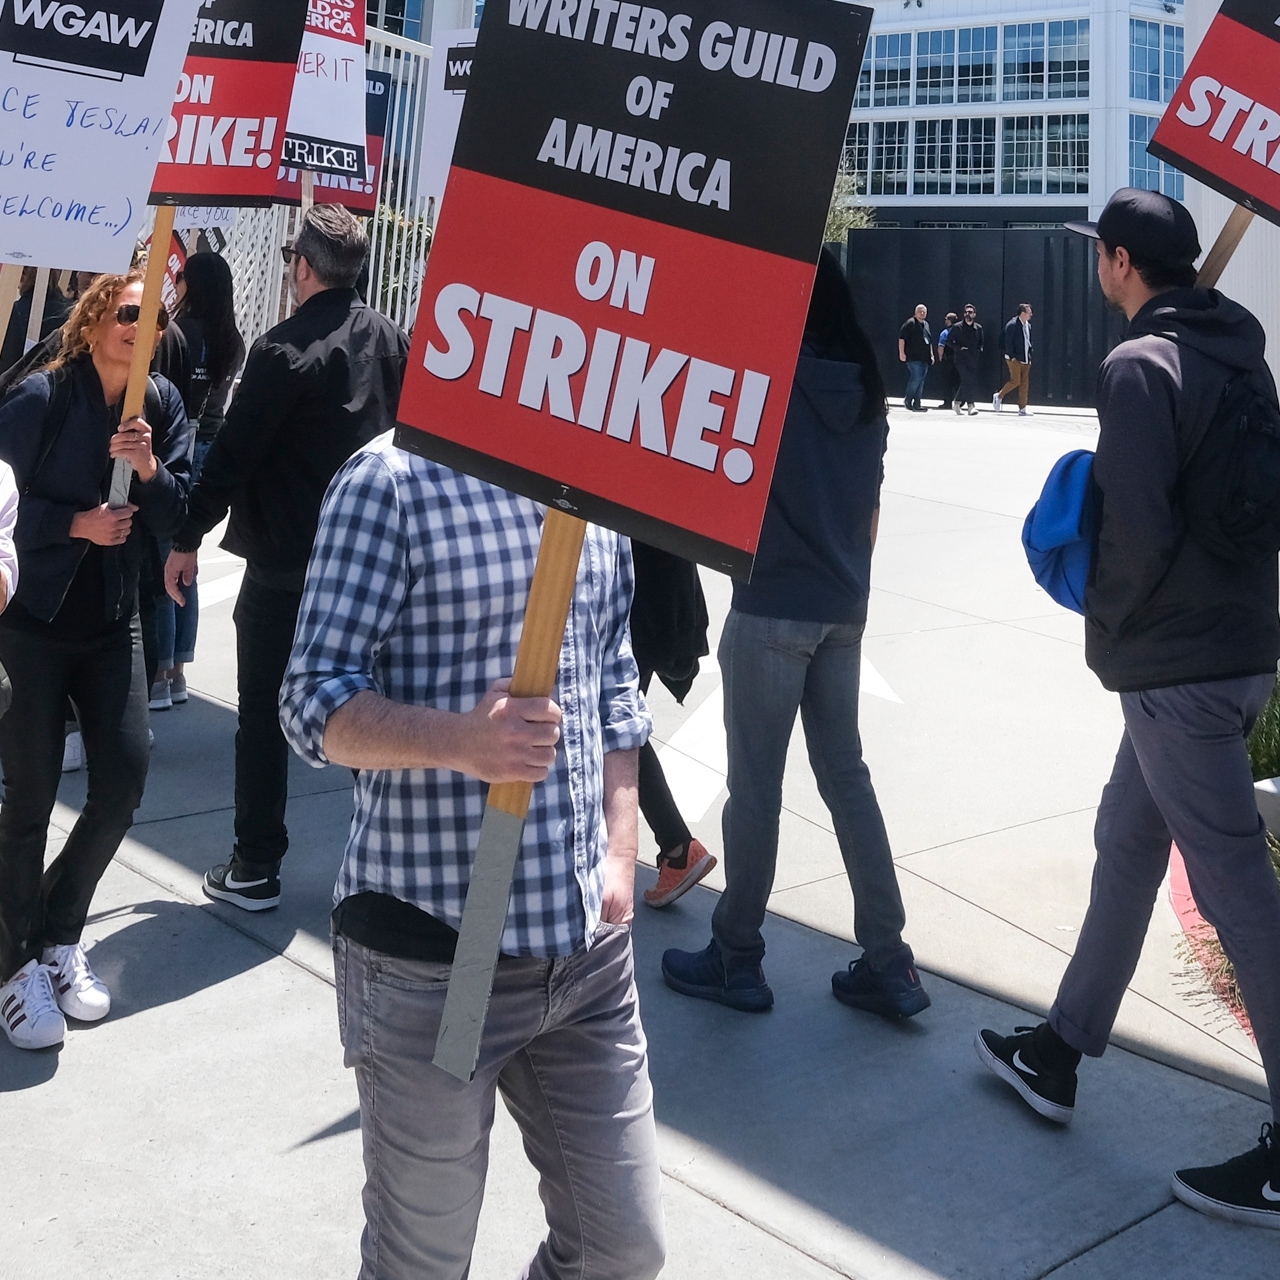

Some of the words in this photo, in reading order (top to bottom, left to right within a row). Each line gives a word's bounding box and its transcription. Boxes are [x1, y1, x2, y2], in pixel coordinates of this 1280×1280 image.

[190, 18, 254, 48] RICA
[305, 12, 357, 37] RICA
[331, 9, 351, 20] OF
[699, 21, 837, 93] GUILD
[173, 73, 215, 105] ON
[625, 75, 675, 120] OF
[65, 99, 164, 151] TESLA!
[158, 114, 278, 170] RIKE!
[281, 138, 358, 172] TRIKE
[536, 118, 732, 211] AMERICA
[168, 253, 182, 275] ON
[575, 241, 656, 315] ON
[423, 282, 771, 485] STRIKE!
